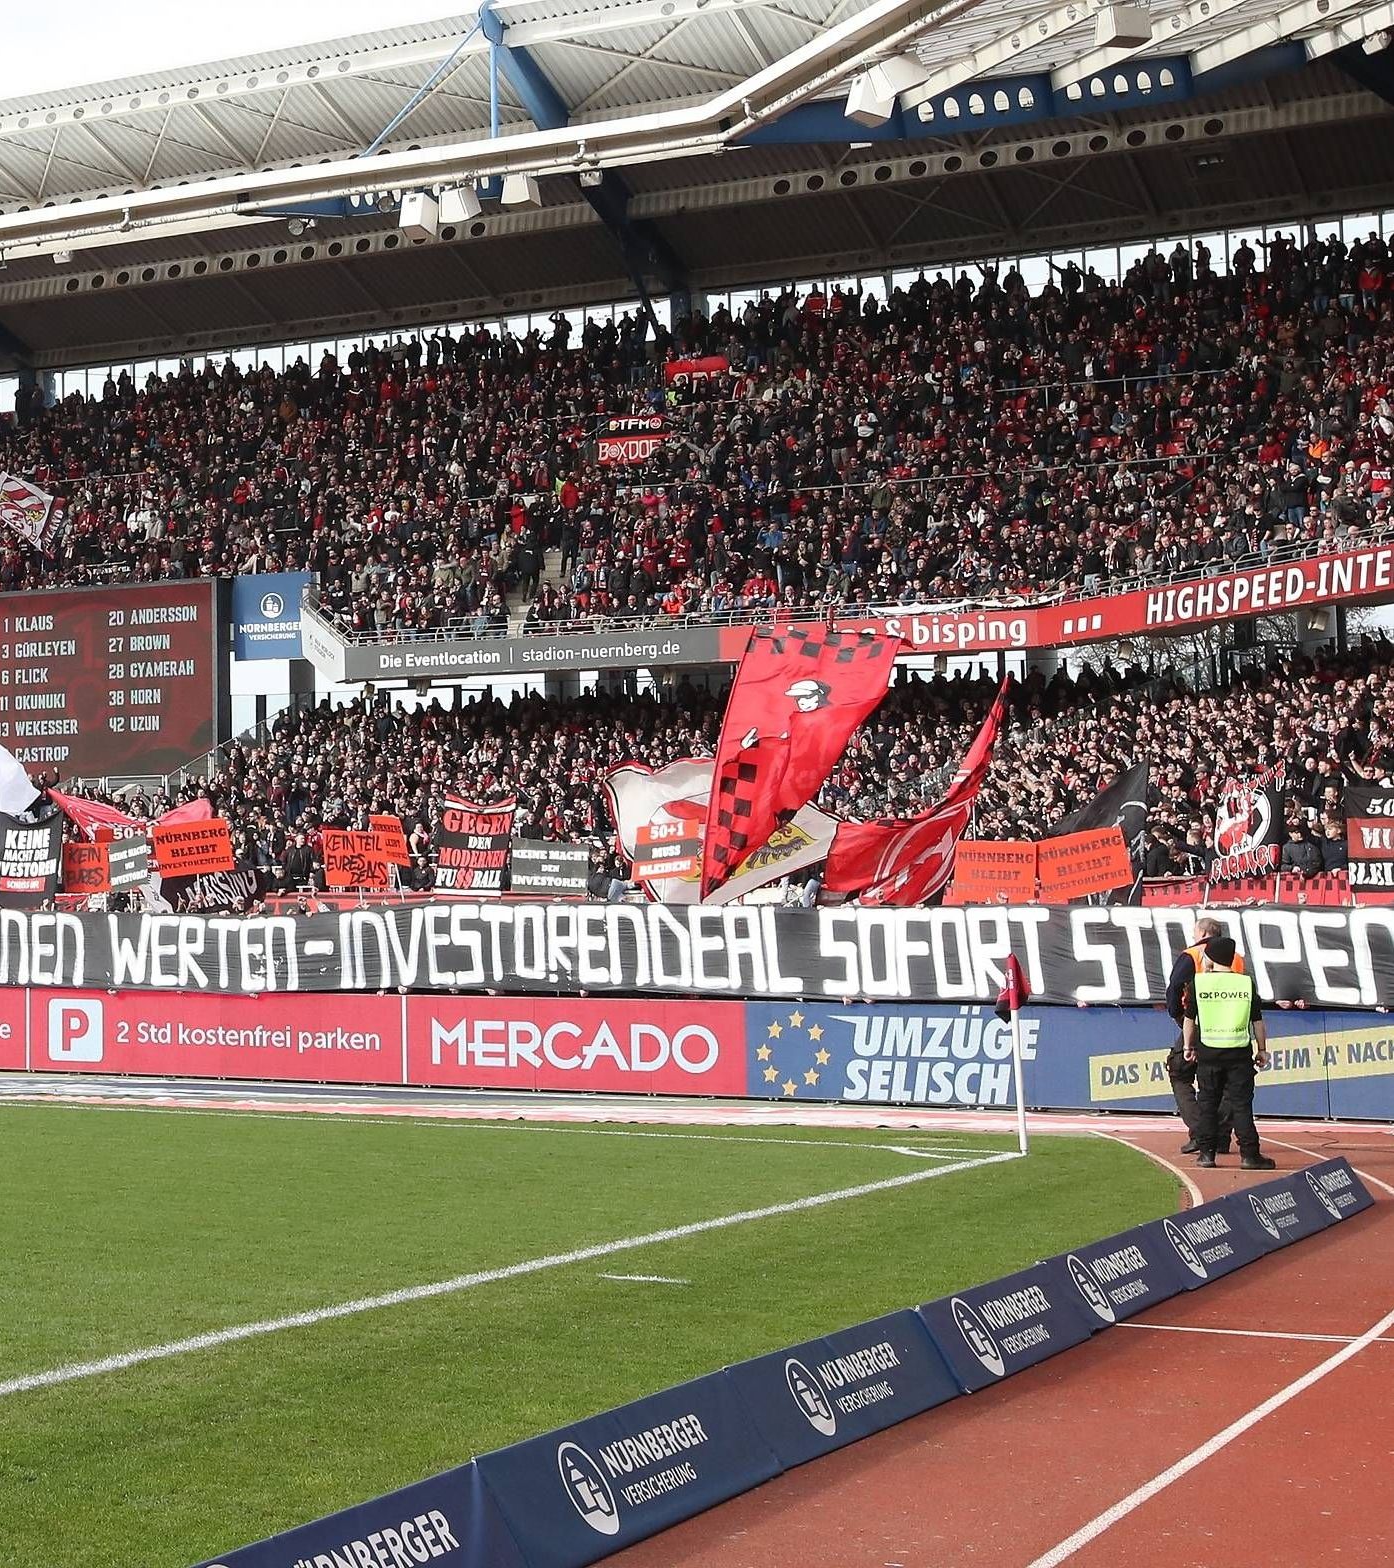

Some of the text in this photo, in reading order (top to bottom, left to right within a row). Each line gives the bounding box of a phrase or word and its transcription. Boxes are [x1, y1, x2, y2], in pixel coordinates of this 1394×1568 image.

[4, 615, 54, 633] 1 KLAUS
[108, 605, 198, 626] 20 ANDERSSON
[249, 632, 297, 641] VERSICHERUNG
[912, 614, 1028, 648] bisping
[1, 644, 9, 659] 3
[108, 634, 171, 653] 27 BROWN
[379, 642, 680, 669] Die Eventlocation stadion-nuernberg.de
[1, 667, 48, 685] 6 FLICK
[108, 659, 195, 680] 28 GYAMERAH
[0, 693, 66, 711] 11 OKUNUKI
[108, 687, 161, 706] 38 HORN
[15, 719, 79, 737] WEKESSER
[108, 715, 160, 732] 42 UZUN
[15, 745, 69, 763] CASTROP
[443, 809, 513, 835] GEGEN
[650, 824, 684, 839] 50+1
[5, 828, 51, 850] KEINE
[113, 828, 154, 840] 50+1
[156, 828, 228, 845] NÜRNBERG
[326, 834, 355, 853] KEIN
[356, 834, 382, 852] TEIL
[468, 836, 493, 850] DEN
[3, 847, 50, 861] MACHT DEN
[69, 847, 102, 865] KEIN
[171, 843, 218, 858] BLEIBT
[438, 847, 506, 868] MODERNEN
[512, 850, 589, 861] KEINE MACHT
[651, 845, 681, 858] MUSS
[958, 850, 1035, 864] NÜRNBERG
[1038, 835, 1123, 863] NÜRNBERG
[326, 852, 366, 873] EURES
[541, 864, 560, 873] DEN
[1056, 855, 1113, 877] BLEIBT
[511, 876, 587, 888] INVESTOREN
[107, 913, 299, 991] WERTEN
[818, 906, 1050, 998] SOFORT
[62, 1008, 381, 1053] P 2 Std kostenfrei parken
[828, 1005, 1040, 1061] UMZÜGE
[431, 1016, 719, 1074] MERCADO
[1101, 1063, 1140, 1086] DAS
[1317, 1045, 1340, 1067] 'A'
[843, 1059, 1012, 1105] SELISCH
[1183, 1213, 1232, 1245] NÜRNBERGER
[1088, 1244, 1148, 1284] NÜRNBERGER
[1108, 1278, 1151, 1306] VERSICHERUNG
[978, 1285, 1052, 1331] NÜRNBERGER
[1000, 1323, 1050, 1355] VERSICHERUNG
[816, 1341, 901, 1391] NÜRNBERGER
[835, 1380, 894, 1416] VERSICHERUNG
[599, 1414, 709, 1479] NÜRNBERGER
[621, 1461, 698, 1507] VERSICHERUNG
